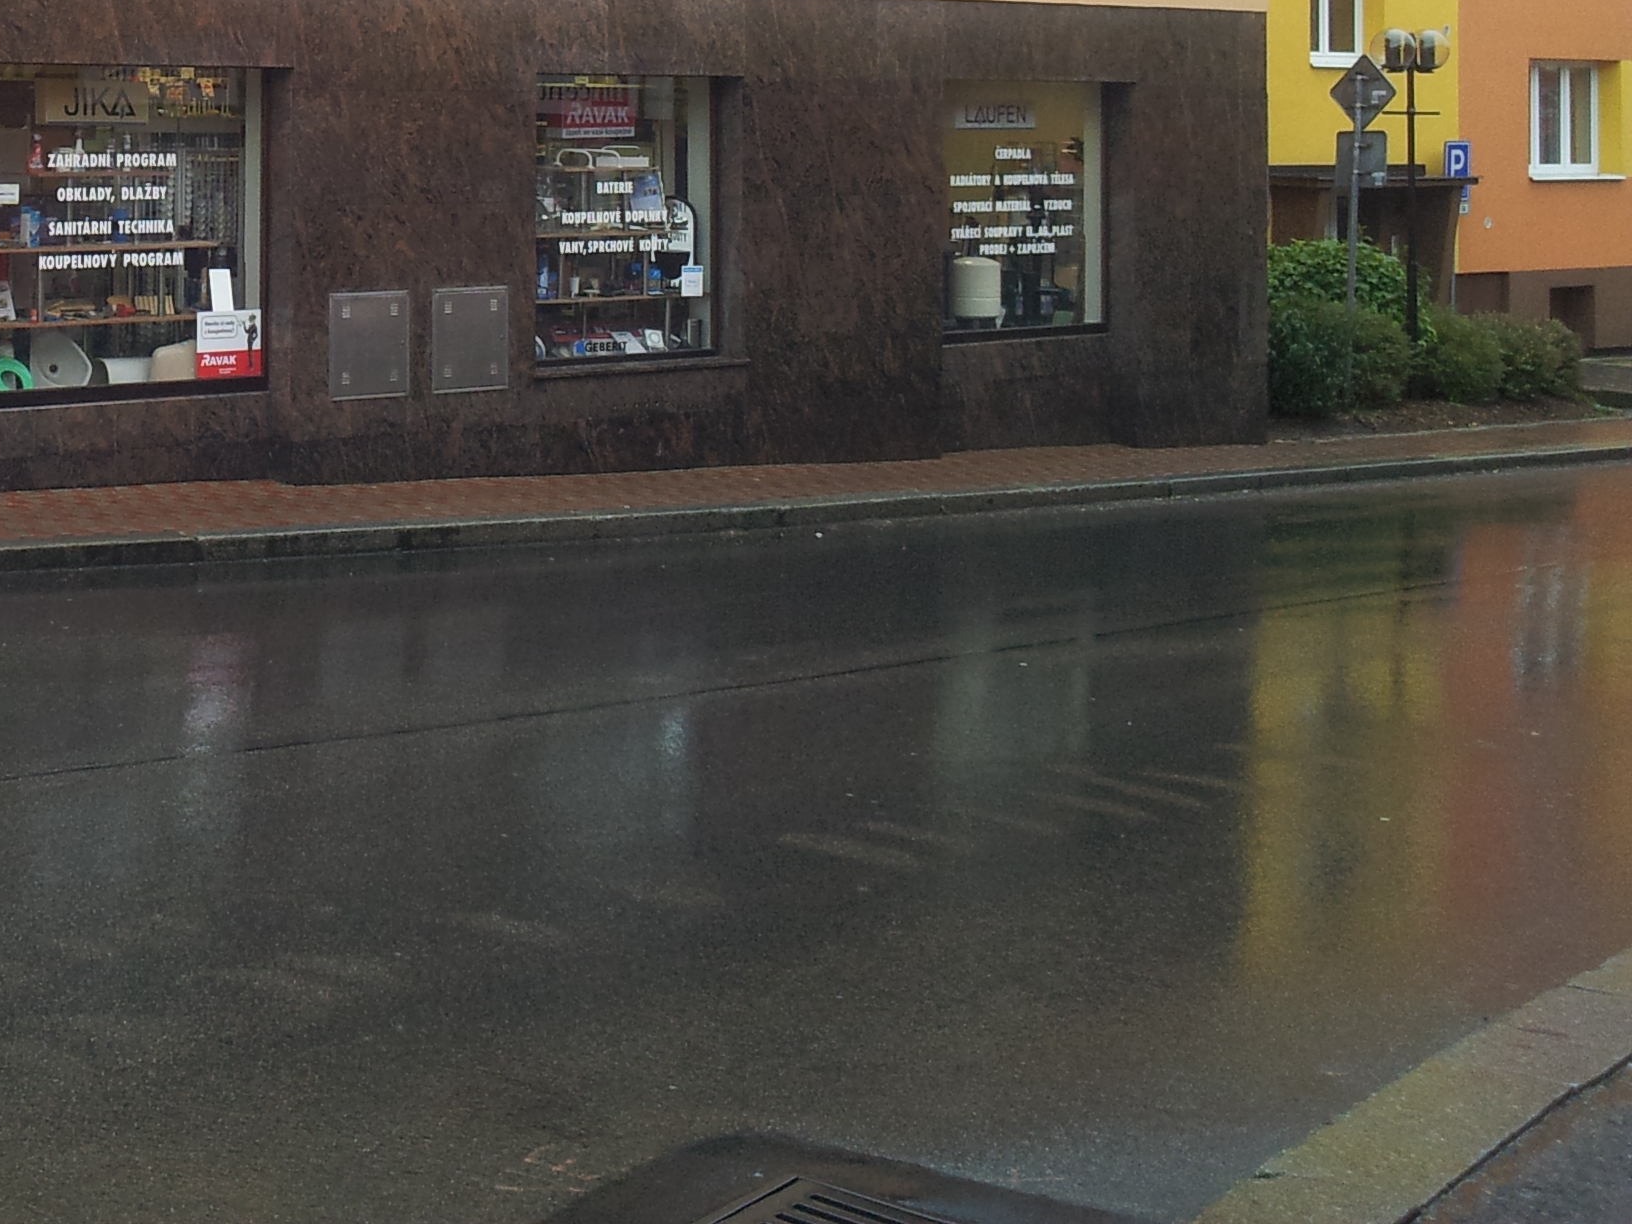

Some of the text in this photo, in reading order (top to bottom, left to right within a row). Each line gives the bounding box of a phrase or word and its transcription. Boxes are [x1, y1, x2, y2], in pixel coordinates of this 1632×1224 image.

[63, 87, 136, 117] JIKA
[566, 102, 629, 124] RAVAK
[965, 105, 1026, 123] LAUFEN
[47, 151, 177, 168] ZAHRADNÍ PROGRAM
[1450, 149, 1465, 177] P
[56, 183, 167, 203] OBKLADY, DLAŽBY
[596, 181, 633, 194] BATERIE
[562, 207, 621, 224] KOUPELNOVÉ
[48, 216, 174, 236] SANITÁRNÍ TECHNIKA
[639, 238, 668, 251] KOUTY
[39, 249, 184, 270] KOUPELNOVÝ PROGRAM
[200, 354, 237, 367] RAVAK
